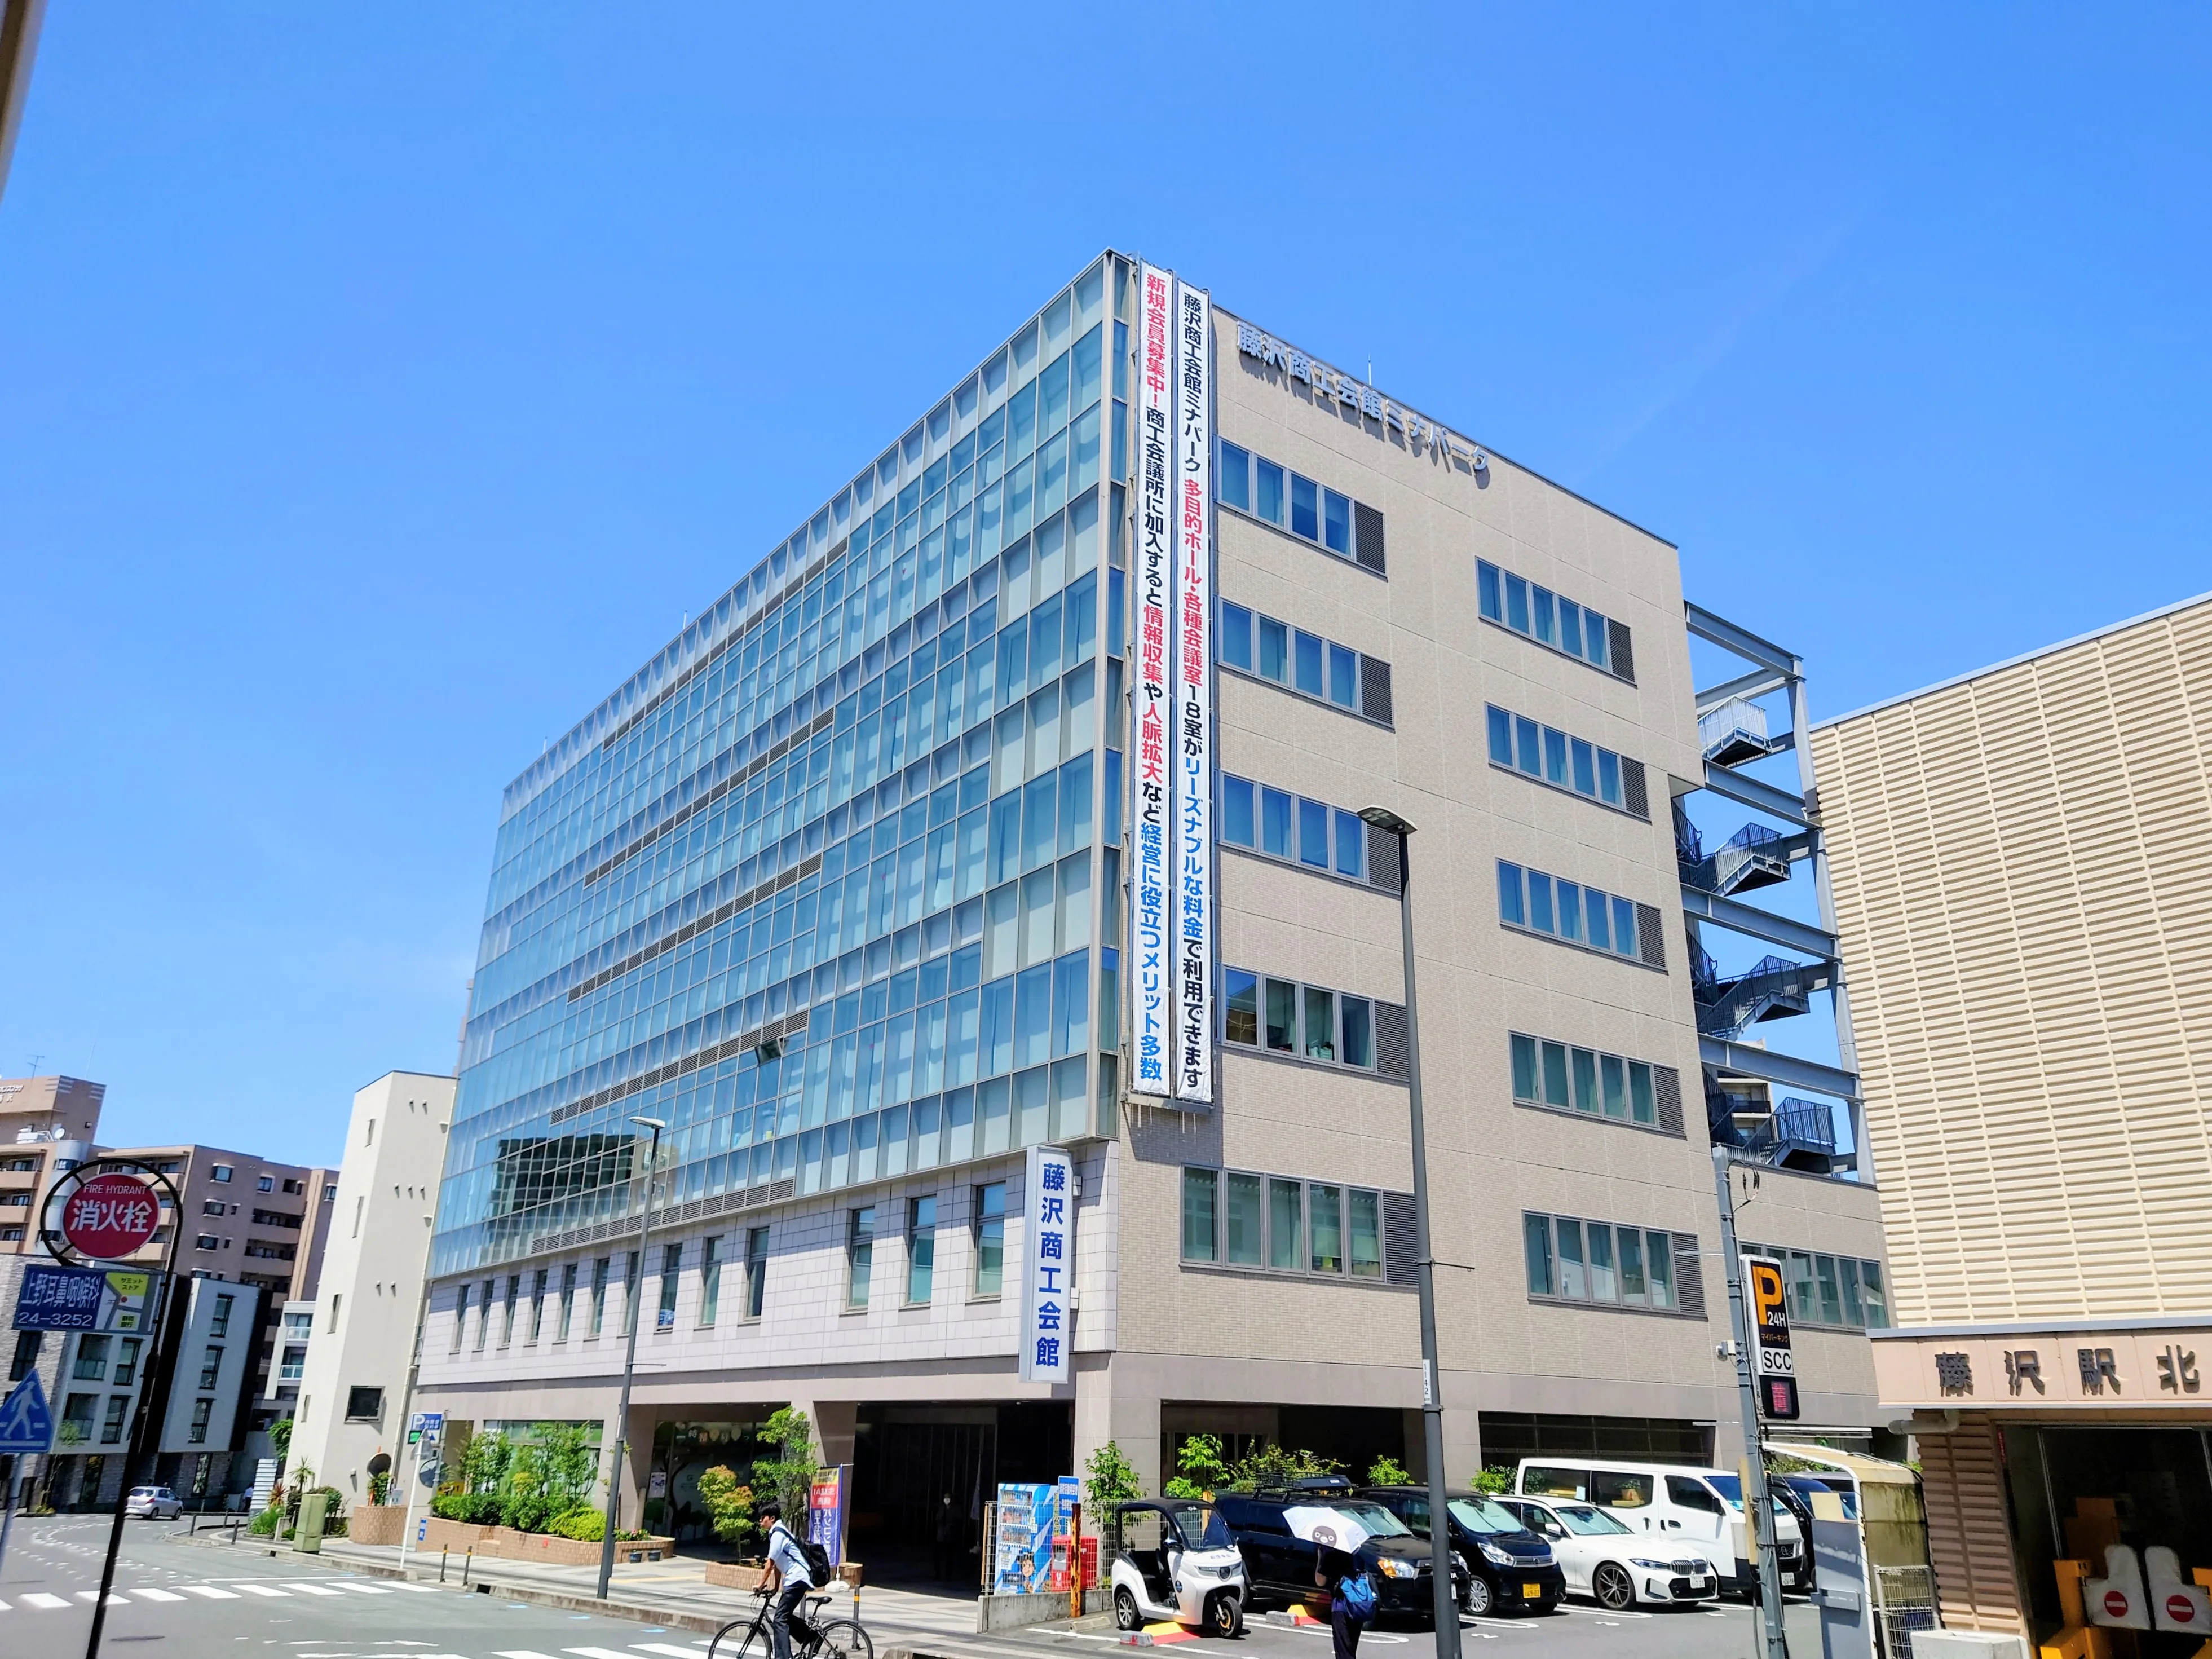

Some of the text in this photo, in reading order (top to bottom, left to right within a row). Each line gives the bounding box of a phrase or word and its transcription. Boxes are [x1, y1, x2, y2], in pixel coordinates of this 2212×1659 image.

[1184, 293, 1202, 473] 藤沢商工会館ミナパーク
[1237, 320, 1489, 471] 藤沢商工会館ミナパーク
[84, 1184, 147, 1195] FIRE HYDRANT
[70, 1199, 152, 1233] 消火栓
[1036, 1163, 1066, 1367] 藤沢商工会館
[21, 1272, 101, 1309] 上野耳鼻咽喉科
[1752, 1265, 1783, 1325] P
[18, 1312, 93, 1326] 24-3252
[1767, 1311, 1786, 1328] 24H
[1763, 1350, 1792, 1371] SCC
